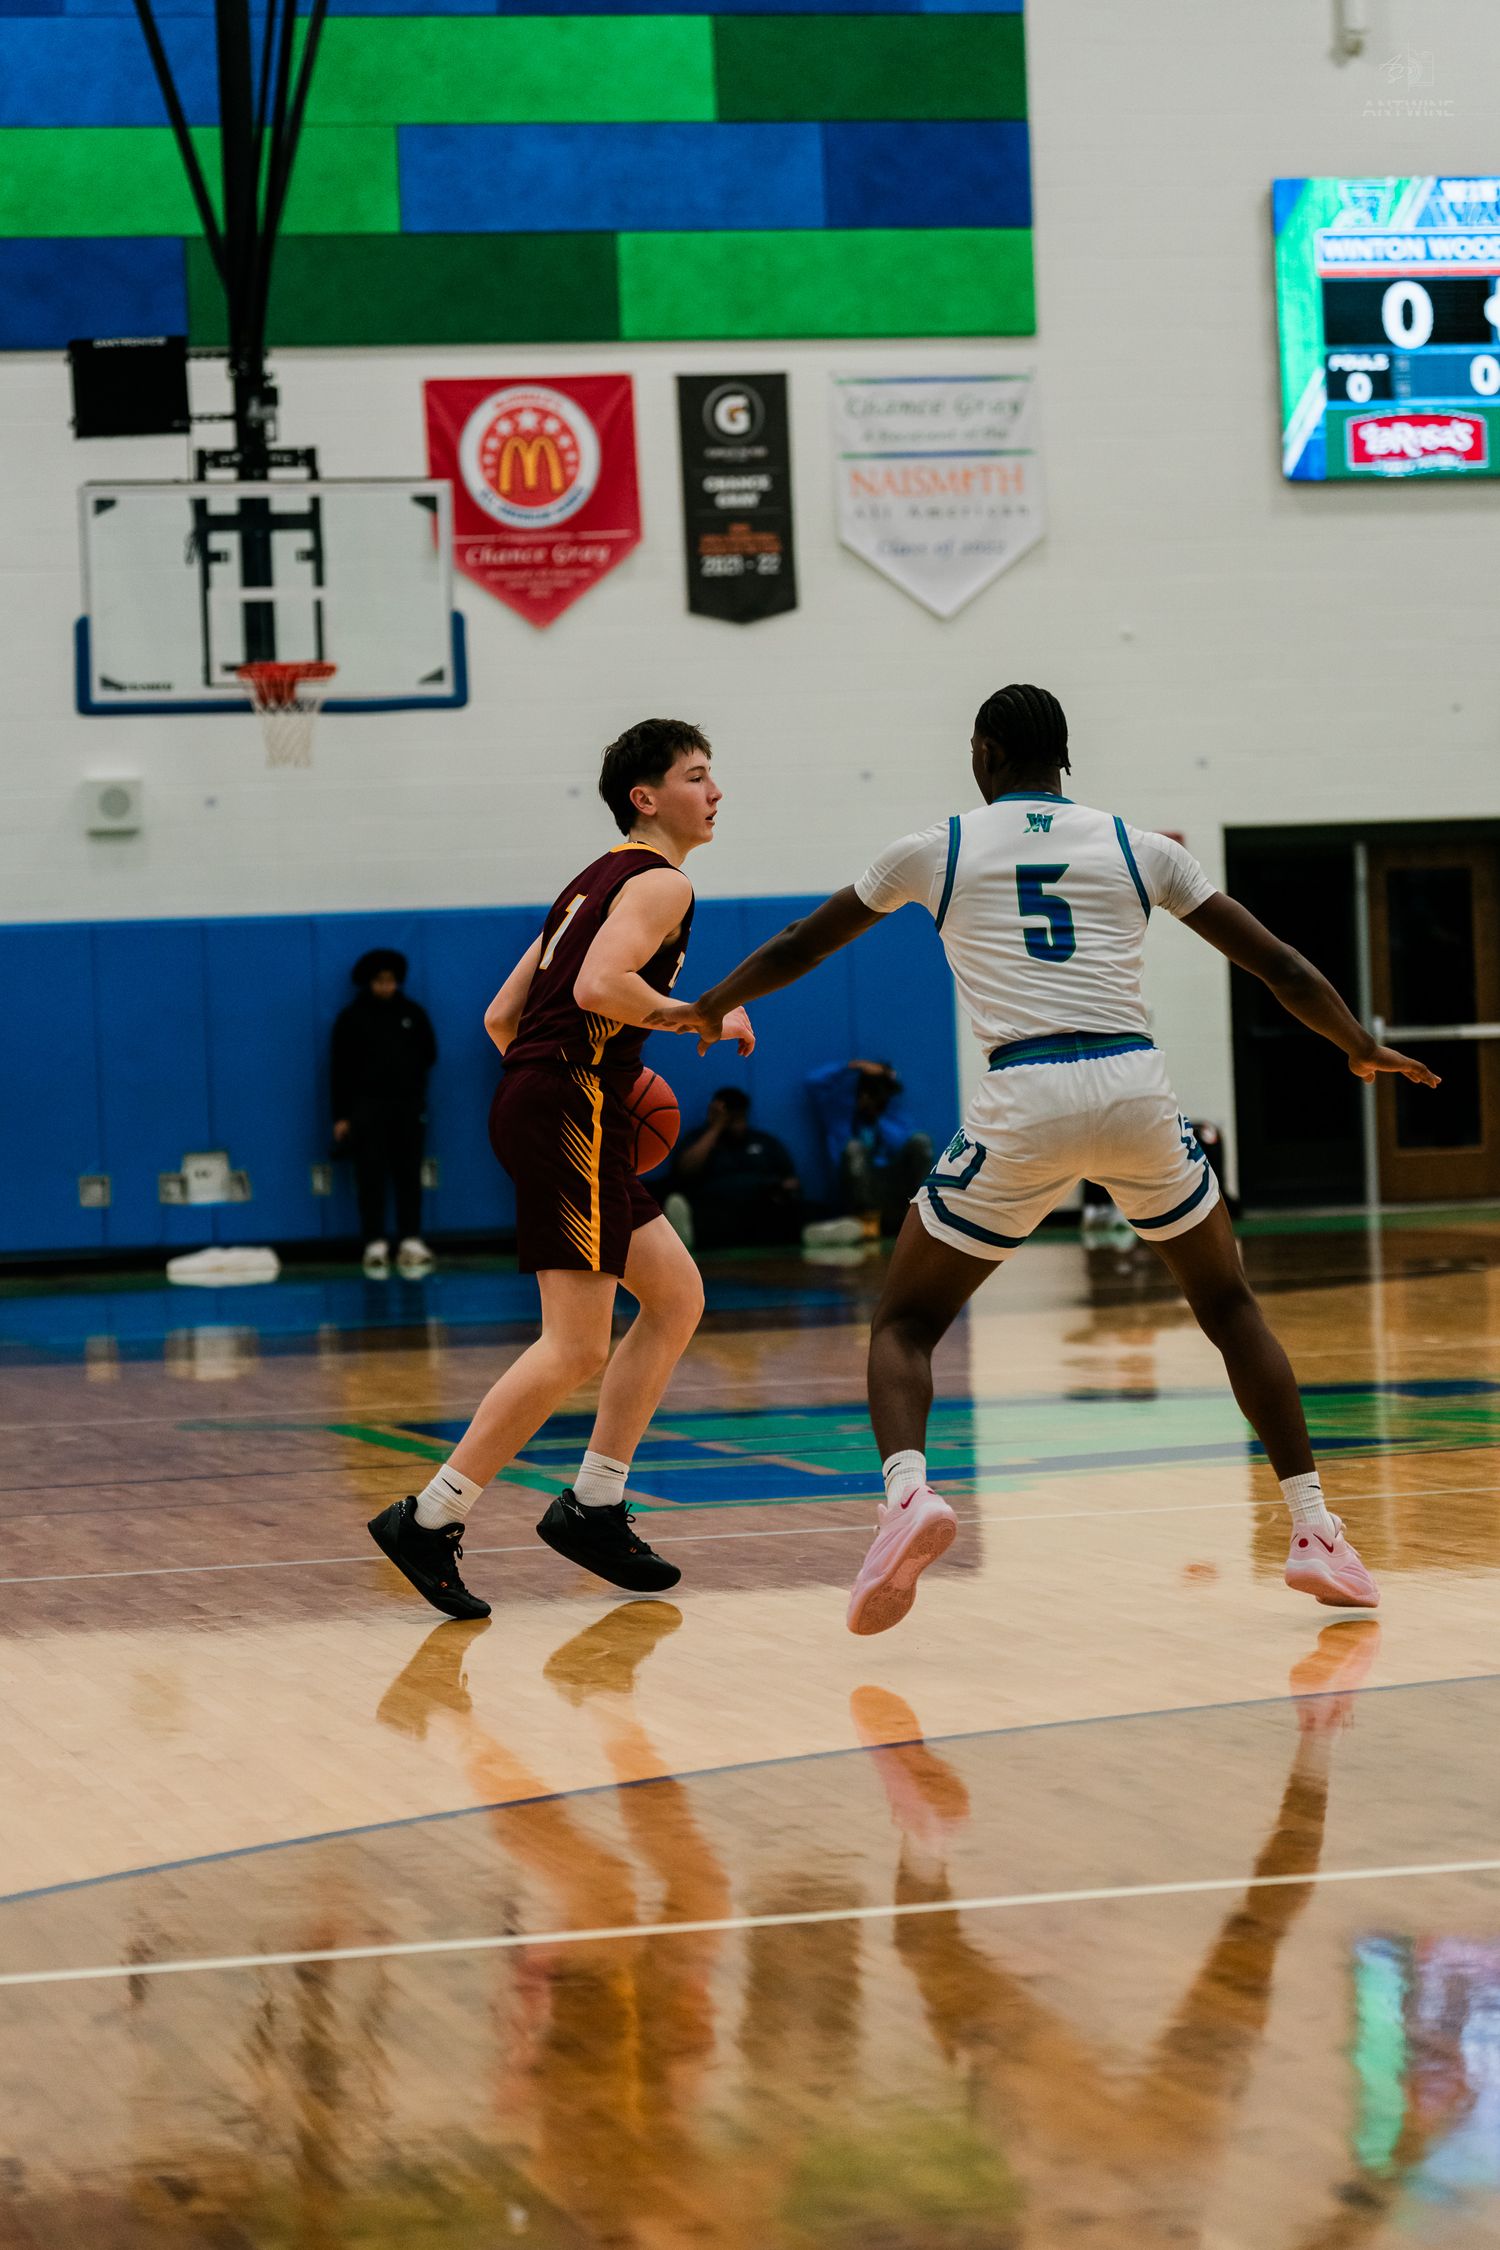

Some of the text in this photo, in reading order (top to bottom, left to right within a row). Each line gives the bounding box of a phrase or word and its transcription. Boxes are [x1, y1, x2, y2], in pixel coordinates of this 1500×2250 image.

[1322, 237, 1425, 261] WINTON
[1382, 280, 1434, 350] 0
[1346, 372, 1373, 403] 0
[1470, 354, 1500, 396] 0
[714, 394, 750, 436] G
[849, 463, 1026, 498] NAISMITH
[540, 893, 588, 970] 1
[1016, 863, 1077, 963] 5
